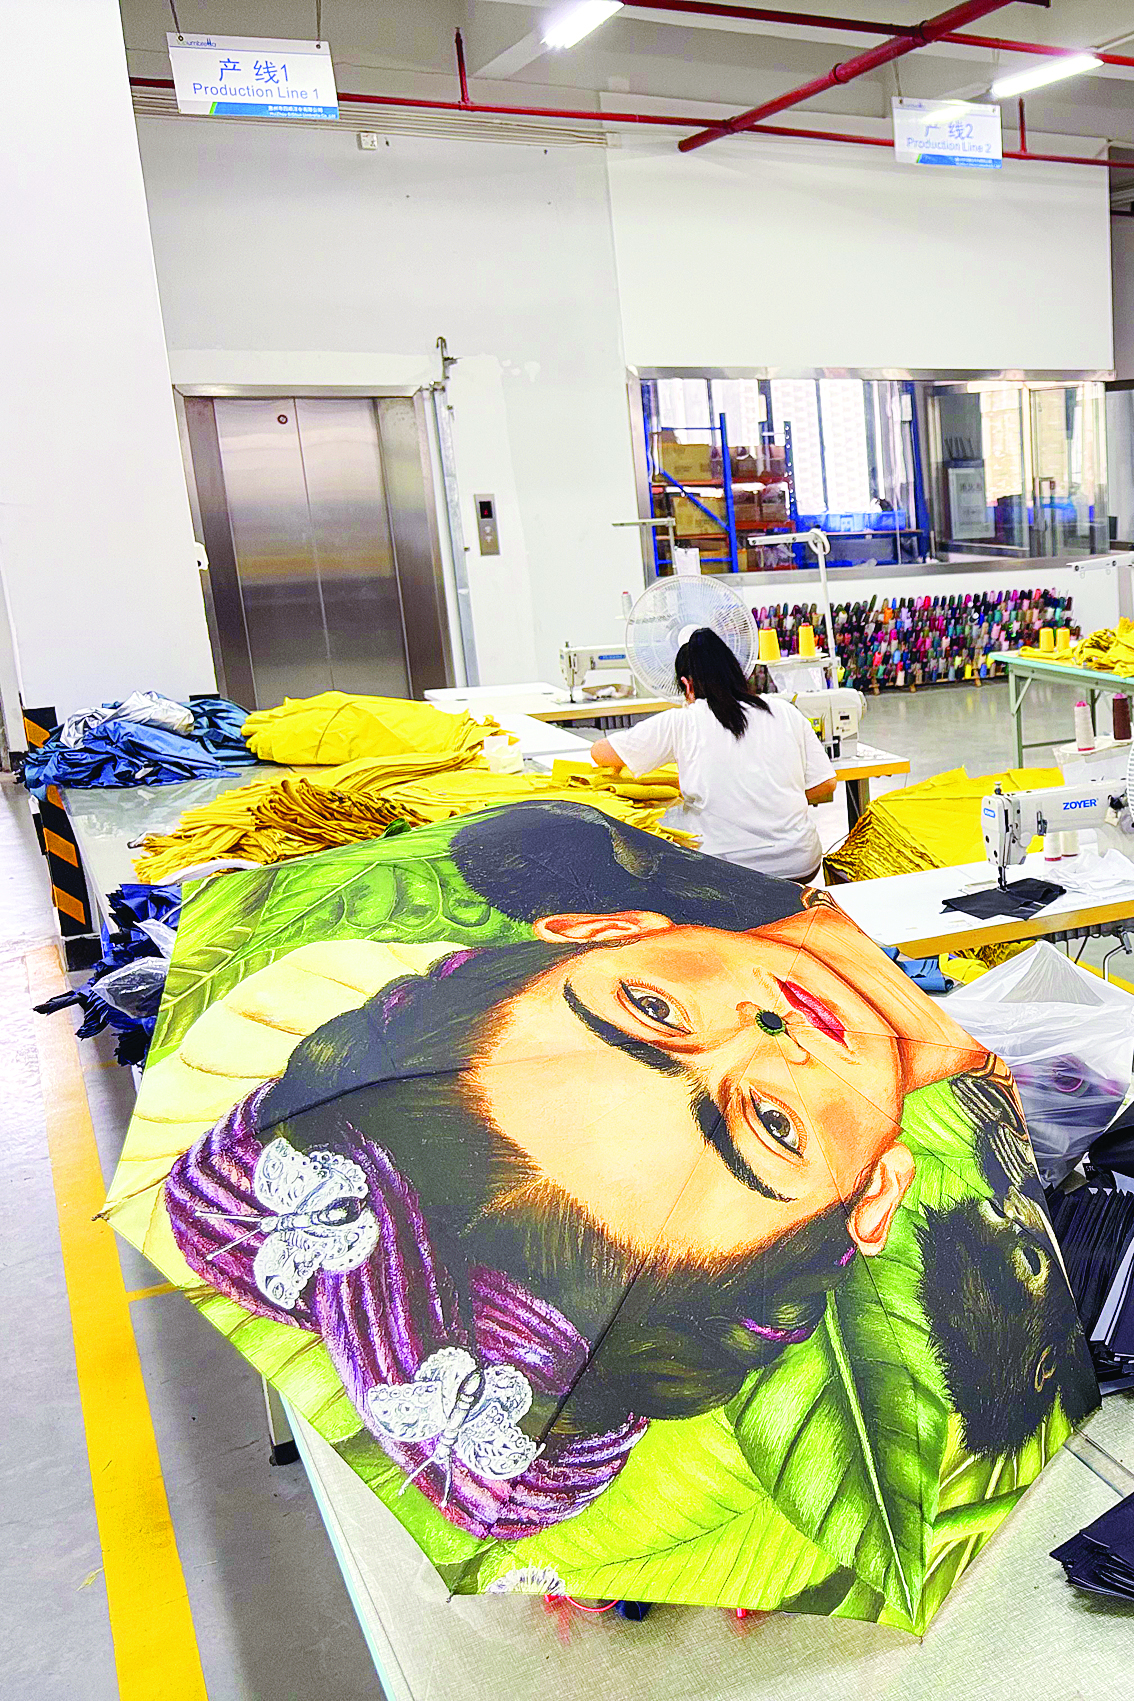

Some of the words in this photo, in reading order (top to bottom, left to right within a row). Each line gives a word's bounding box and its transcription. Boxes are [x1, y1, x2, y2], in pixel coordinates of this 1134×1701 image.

[219, 58, 289, 84] 产线1
[193, 82, 273, 97] Production
[278, 86, 308, 99] Line
[312, 88, 319, 100] 1
[907, 137, 960, 151] Production
[962, 141, 983, 153] Line
[985, 143, 992, 153] 2
[1062, 798, 1098, 811] ZOYER
